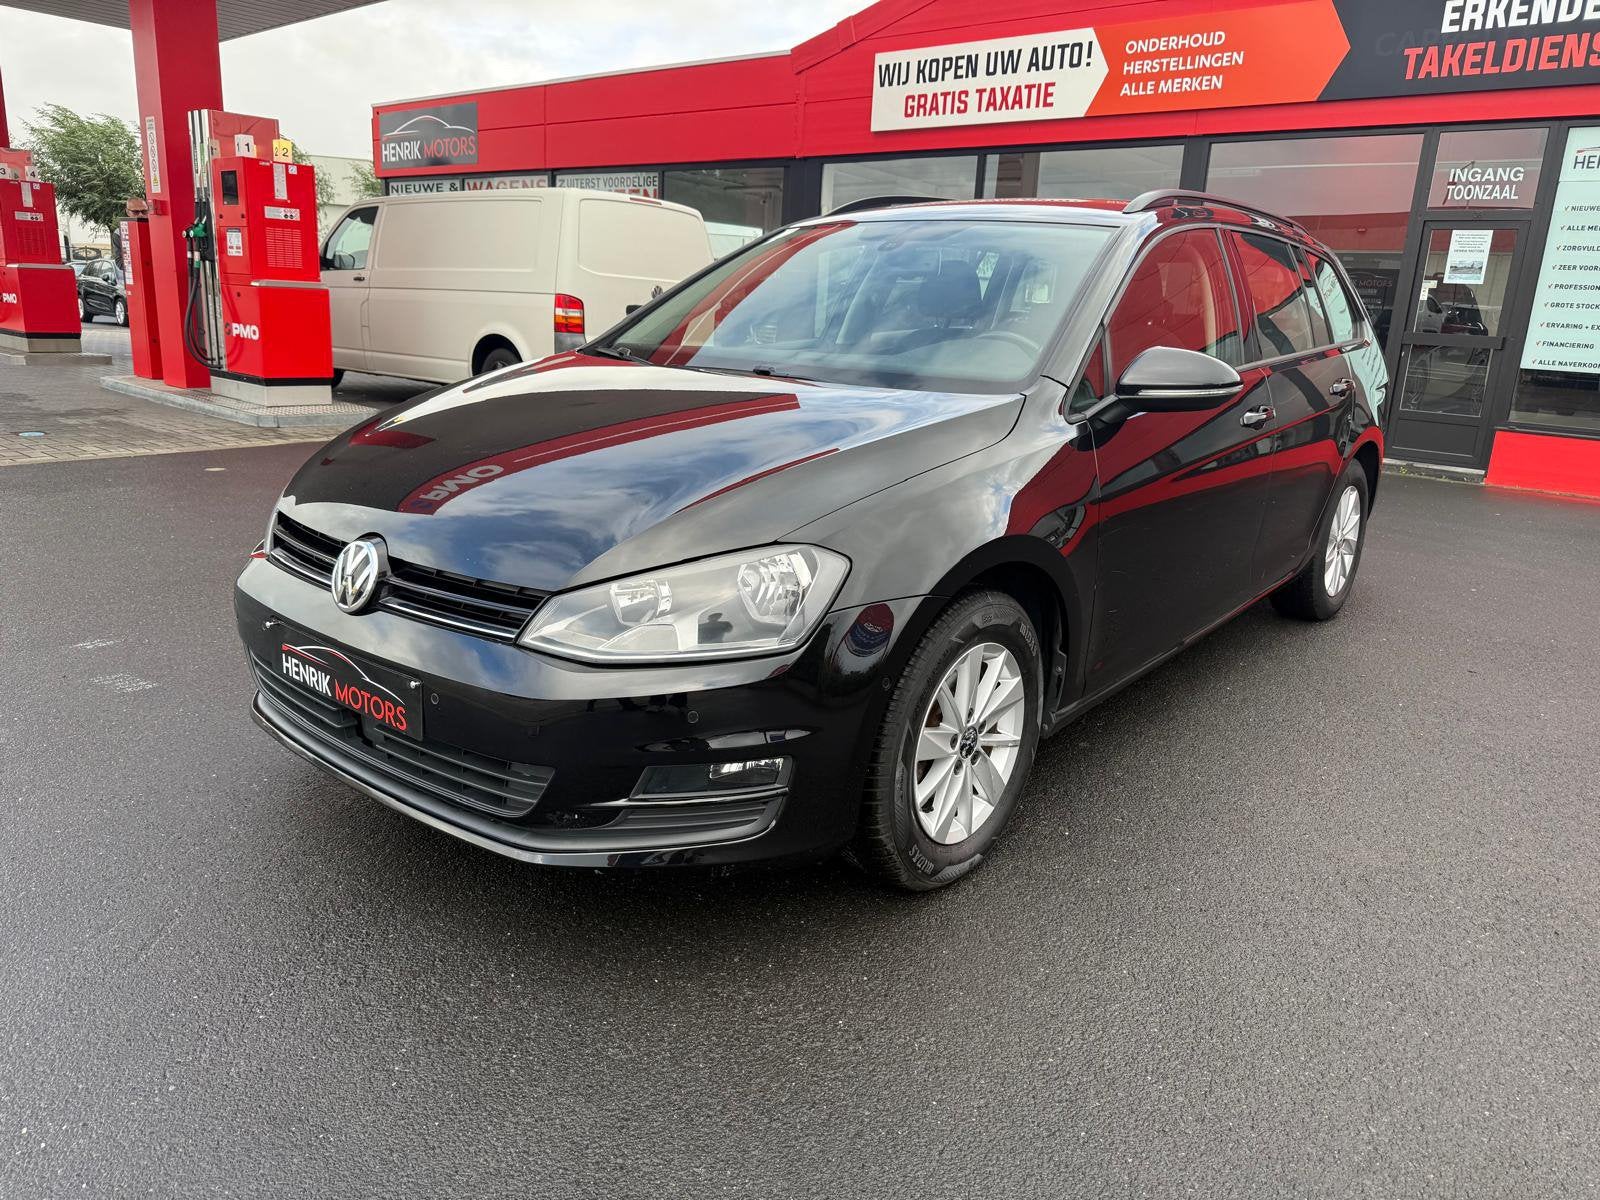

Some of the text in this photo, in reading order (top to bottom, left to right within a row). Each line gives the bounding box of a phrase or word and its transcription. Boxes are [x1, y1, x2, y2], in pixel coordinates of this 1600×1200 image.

[1124, 31, 1226, 54] ONDERHOUD
[878, 40, 1094, 88] WIJ KOPEN UW AUTO!
[1123, 51, 1244, 76] HERSTELLINGEN
[1120, 75, 1223, 97] ALLE MERKEN
[903, 81, 1056, 119] GRATIS TAXATIE
[282, 147, 289, 157] 2
[382, 135, 477, 163] HENRIK MOTORS
[602, 175, 658, 189] VOORDELIGE
[1448, 166, 1525, 183] INGANG
[390, 182, 459, 194] NIEUWE &
[1446, 184, 1519, 200] TOONZAAL
[231, 322, 260, 341] PMO
[1546, 322, 1583, 330] ERVARING
[1542, 340, 1595, 350] FINANCIERING
[281, 652, 408, 731] HENRIK MOTORS
